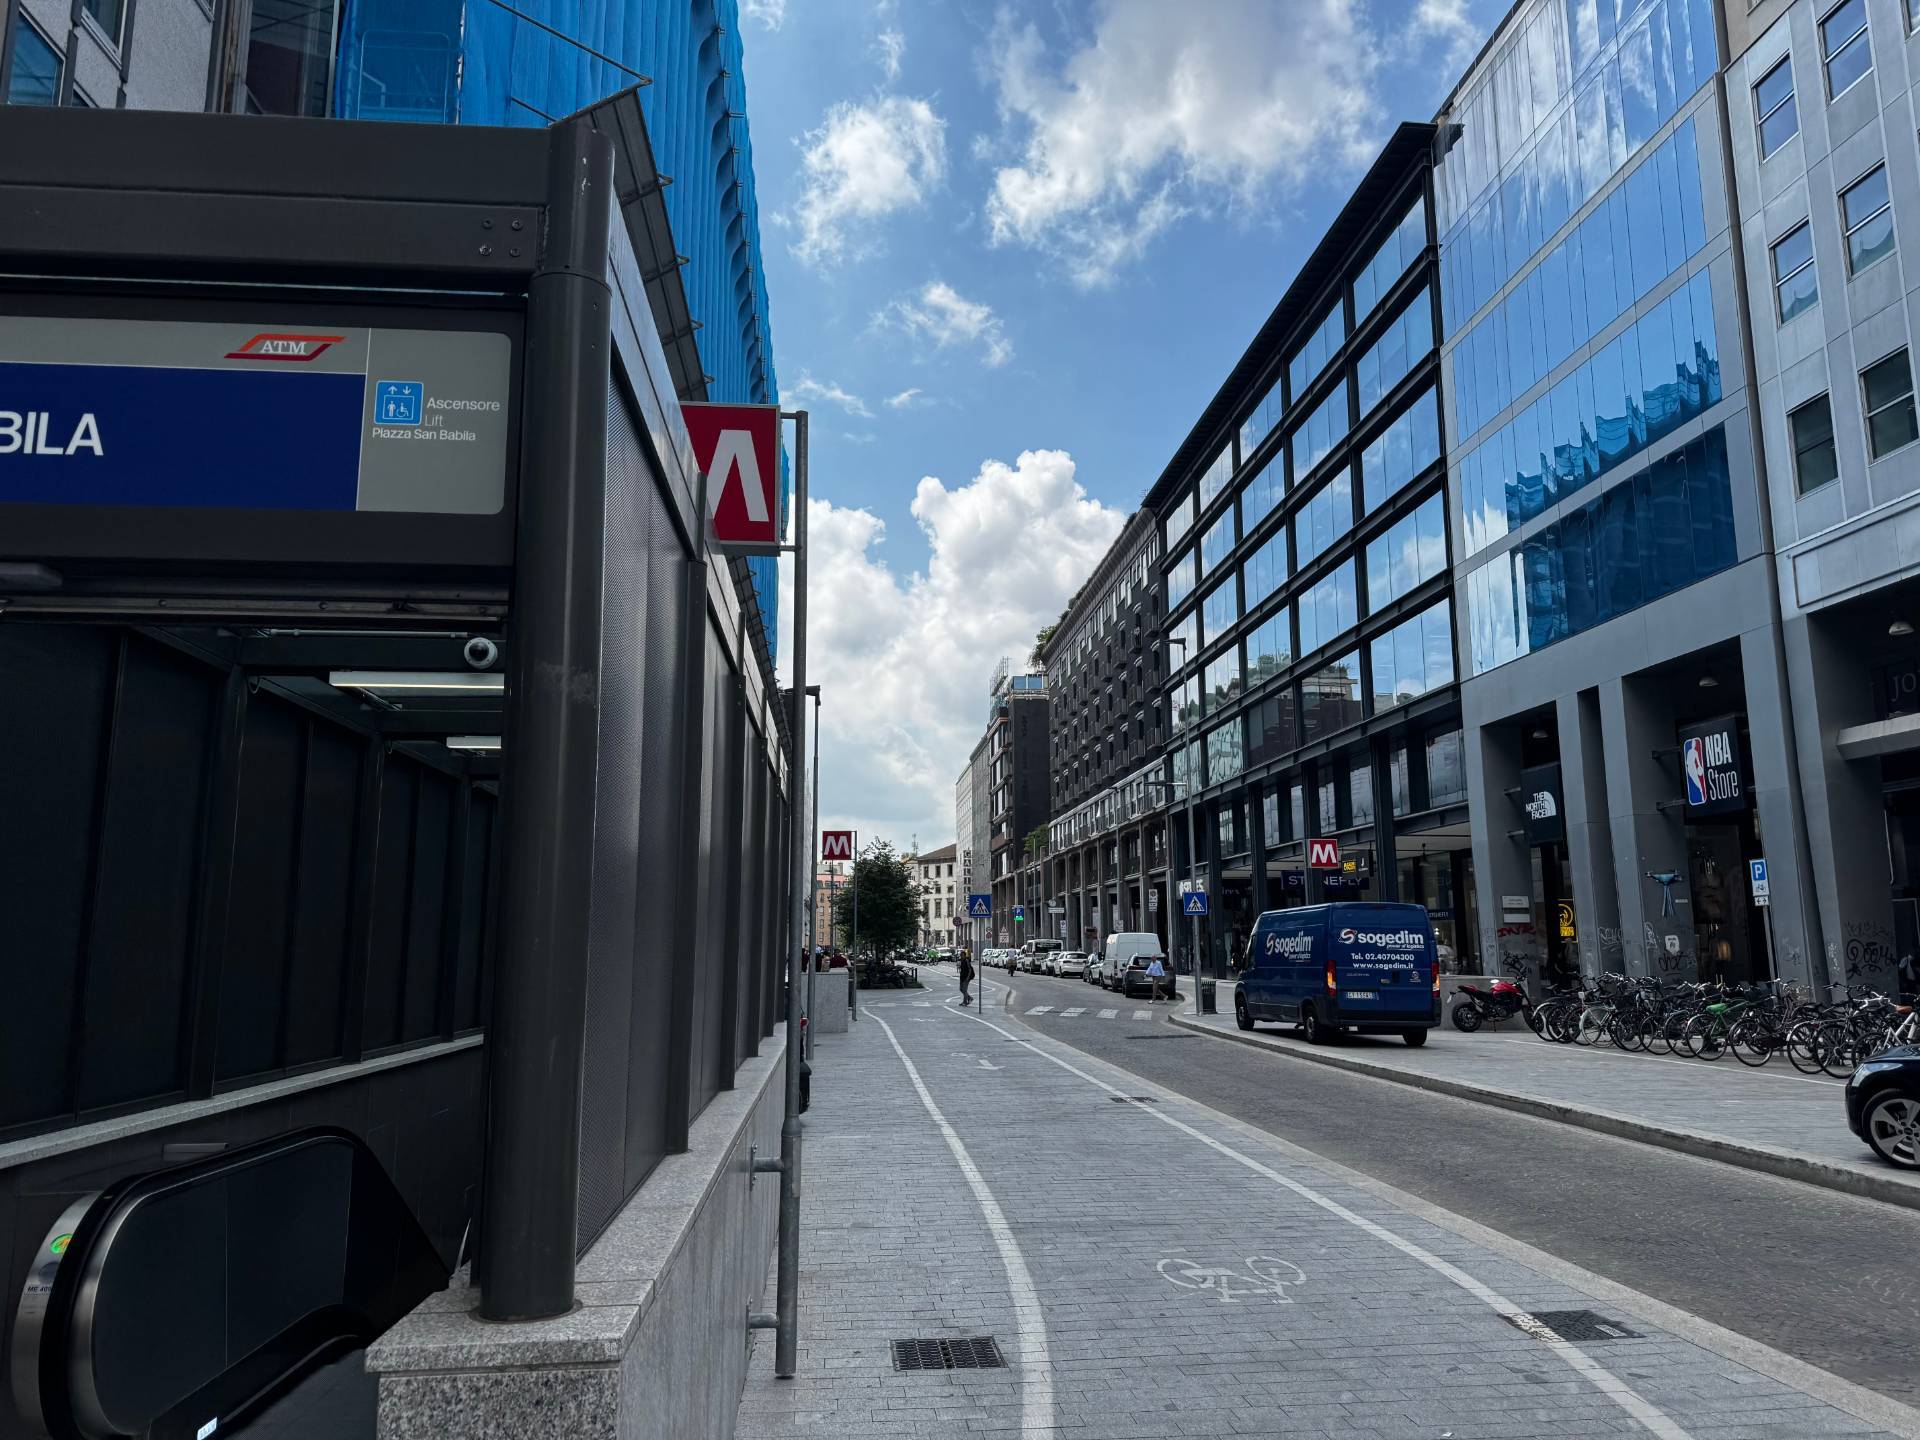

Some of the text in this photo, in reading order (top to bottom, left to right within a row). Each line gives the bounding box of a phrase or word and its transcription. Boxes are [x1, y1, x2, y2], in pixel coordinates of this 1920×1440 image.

[260, 340, 307, 356] ATM
[426, 396, 501, 412] Ascensore
[425, 413, 444, 428] Lift
[0, 410, 105, 457] BILA
[372, 427, 477, 442] Piazza San Babila
[1704, 731, 1733, 767] NBA
[1707, 767, 1739, 802] Store
[1532, 791, 1545, 802] THE
[1525, 800, 1546, 813] NORTH
[1531, 809, 1548, 821] FACE
[825, 835, 851, 856] M
[1311, 843, 1338, 864] M
[1754, 864, 1763, 879] P
[1275, 930, 1312, 958] sogedim
[1357, 930, 1424, 947] sogedim
